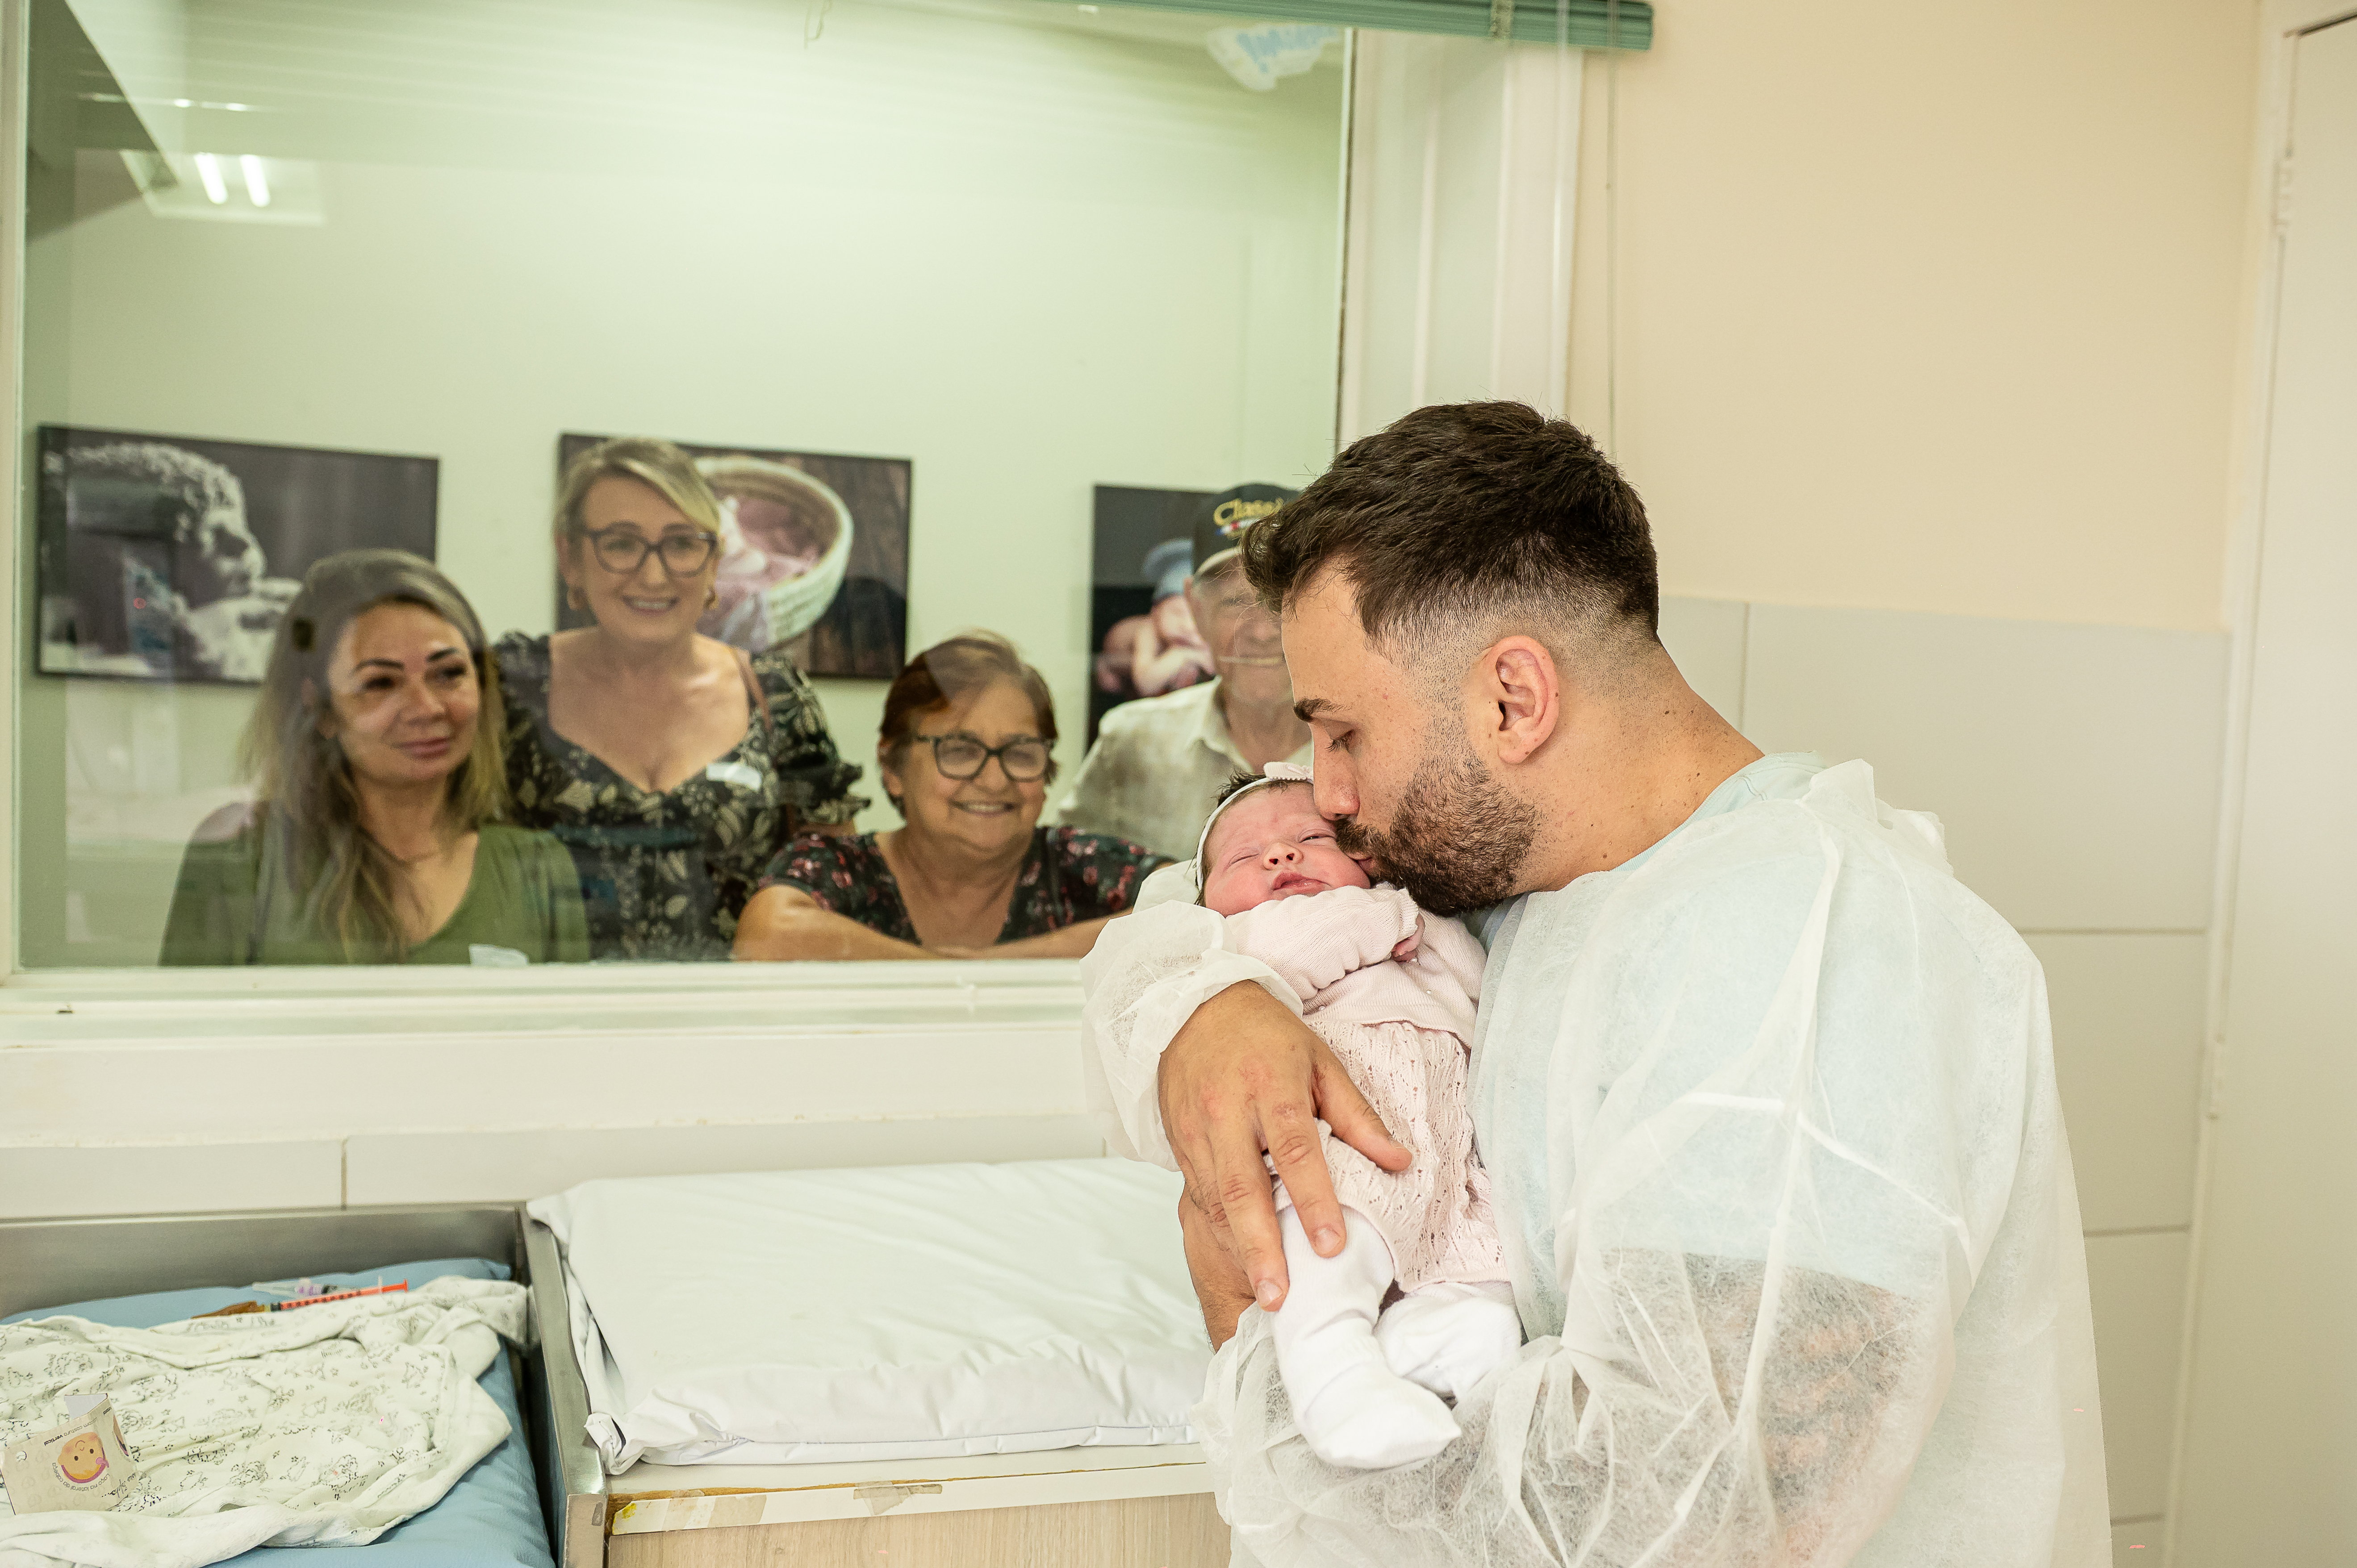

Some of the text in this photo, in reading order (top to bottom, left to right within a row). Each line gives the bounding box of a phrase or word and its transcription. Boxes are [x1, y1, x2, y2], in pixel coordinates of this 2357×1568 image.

[64, 1426, 82, 1436] costura
[44, 1435, 63, 1446] vertical
[52, 1463, 63, 1482] cabeça
[98, 1473, 110, 1485] Laço
